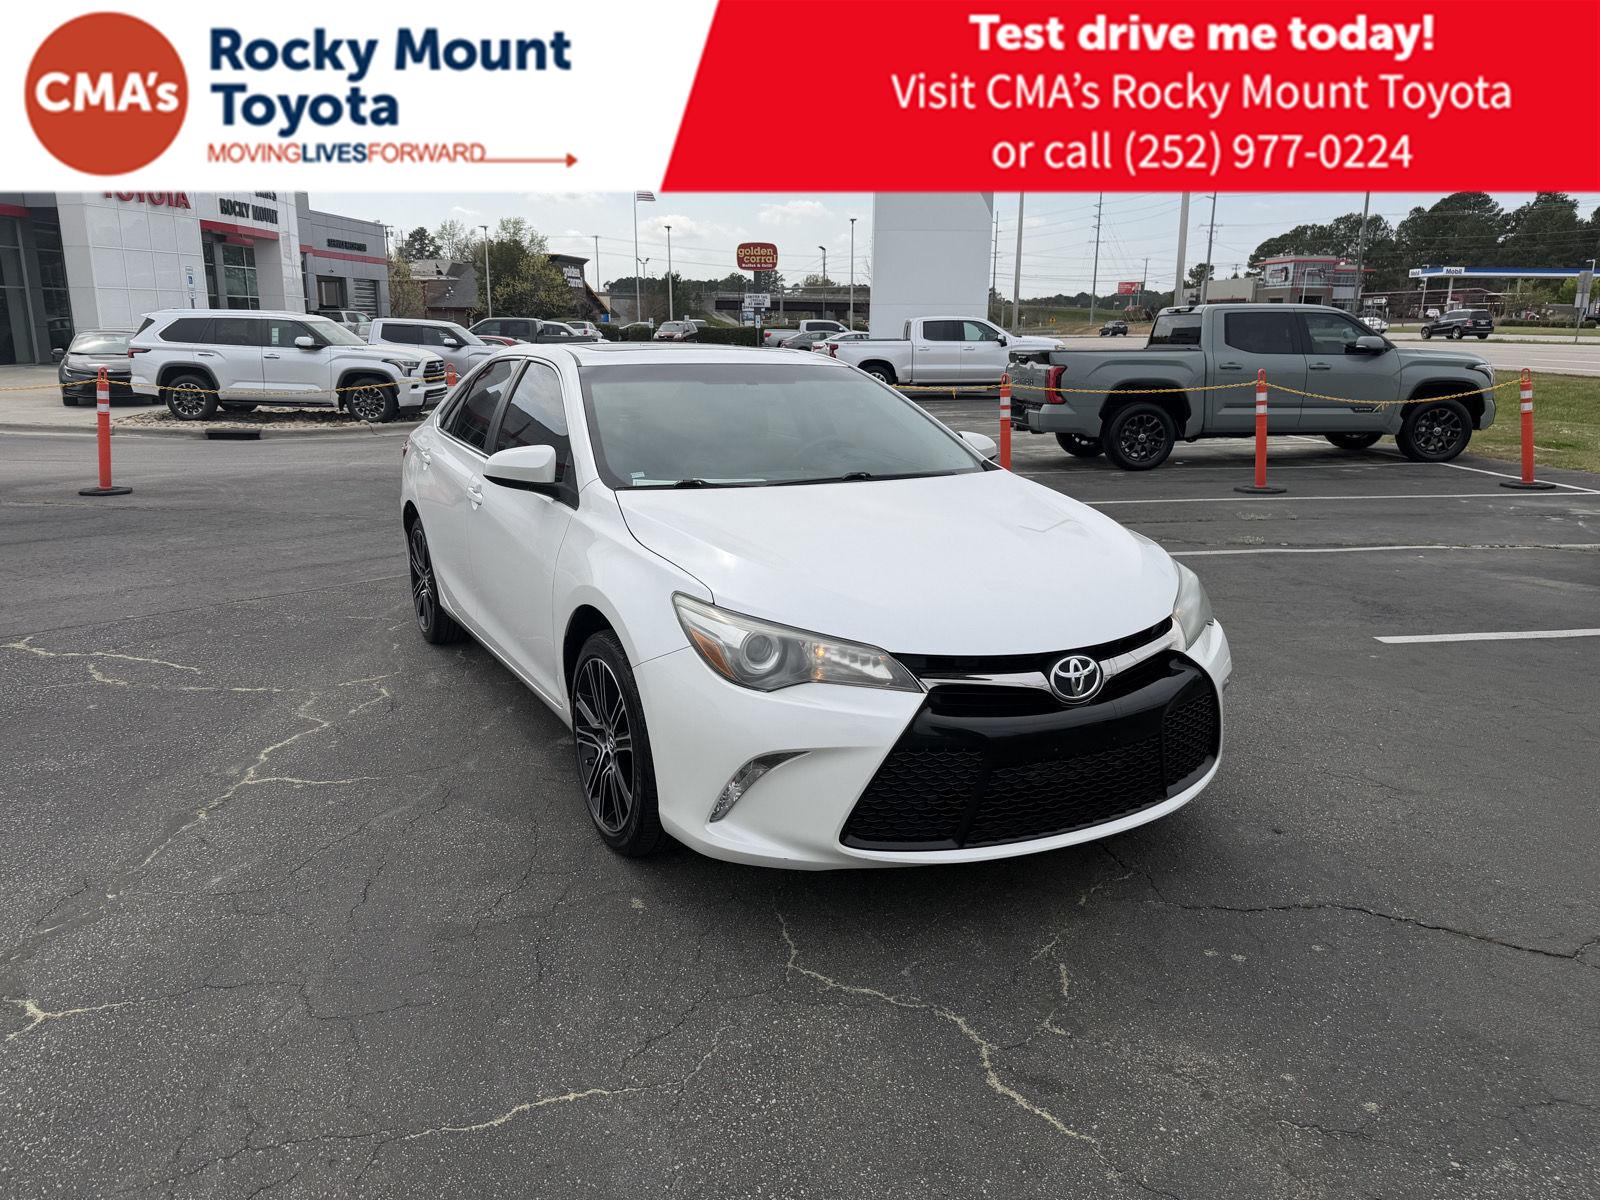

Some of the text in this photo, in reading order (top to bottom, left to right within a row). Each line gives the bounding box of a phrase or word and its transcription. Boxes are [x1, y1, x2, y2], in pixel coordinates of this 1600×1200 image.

[219, 197, 279, 224] ROCKY MOUNT
[738, 246, 774, 257] golden
[743, 255, 777, 263] corral
